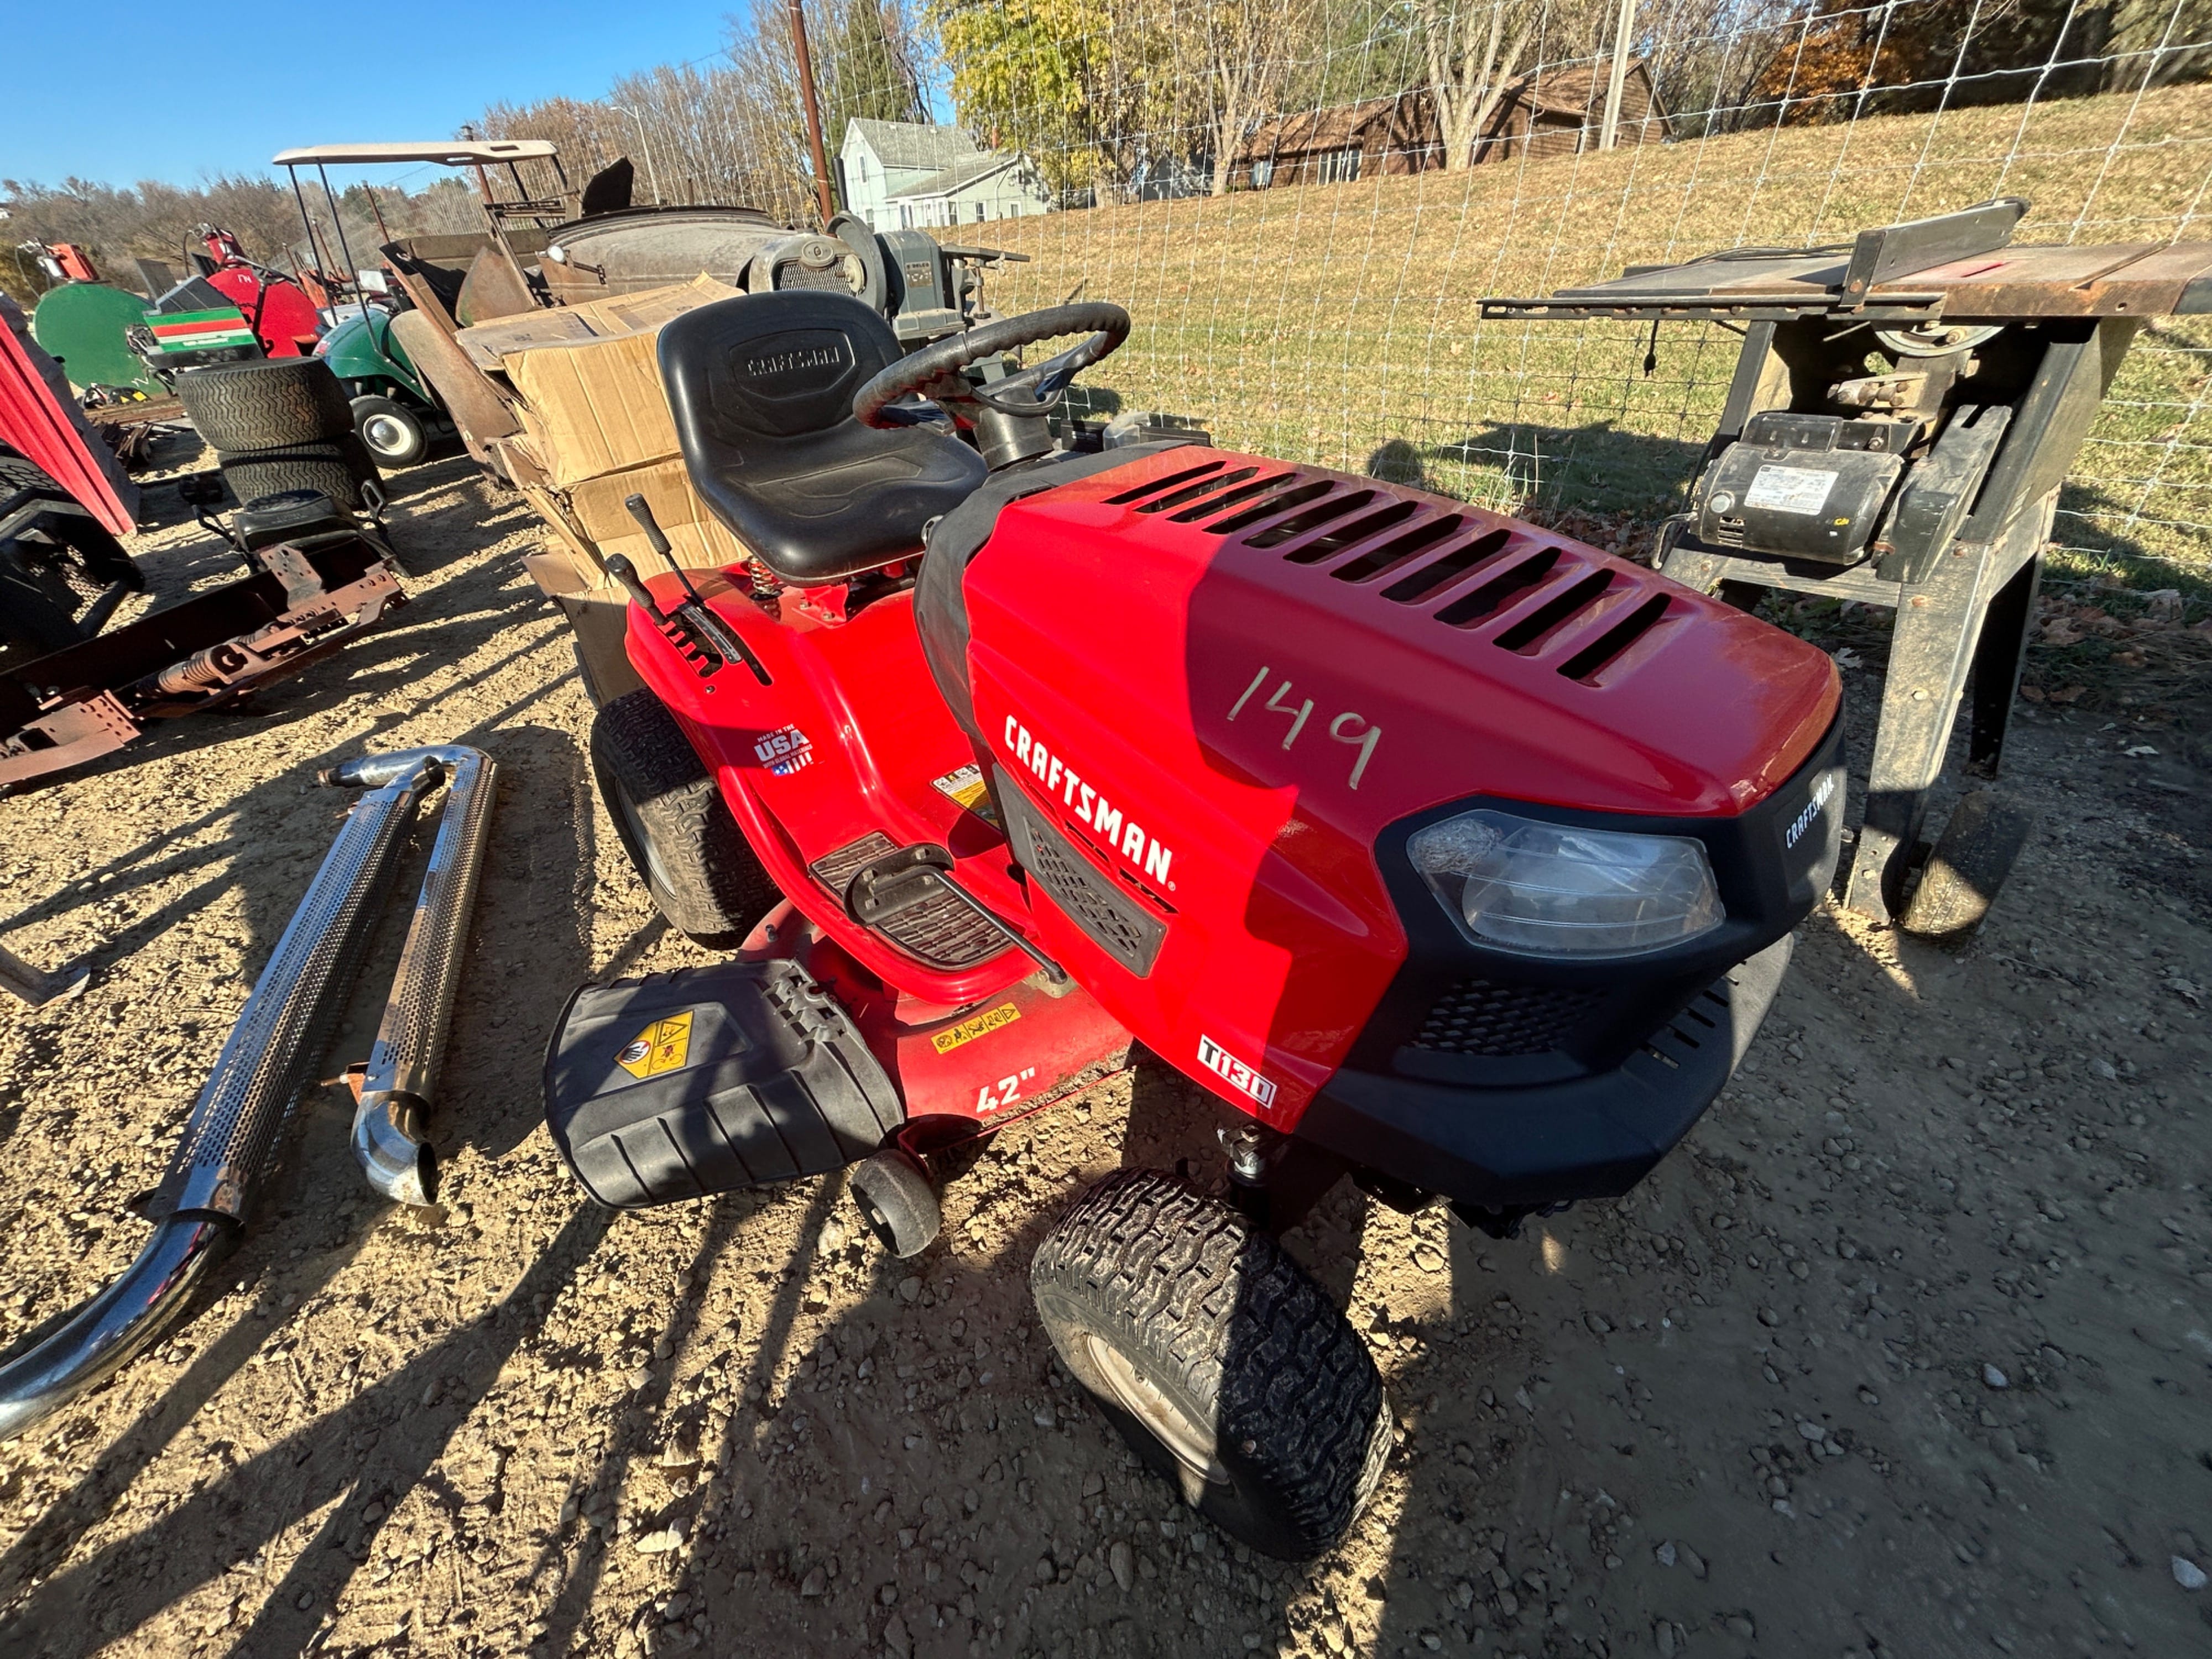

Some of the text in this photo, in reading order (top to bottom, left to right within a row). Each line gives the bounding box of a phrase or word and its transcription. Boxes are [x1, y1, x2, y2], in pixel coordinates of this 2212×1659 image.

[748, 347, 840, 376] CRAFTSMAN
[754, 729, 810, 761] USA
[757, 732, 774, 742] MADE
[782, 723, 795, 732] THE
[1227, 666, 1381, 790] 149
[1004, 714, 1172, 885] CRAFTSMAN
[1786, 774, 1834, 849] CRAFTSMAN
[976, 1066, 1035, 1113] 42"
[1202, 1037, 1274, 1106] T130
